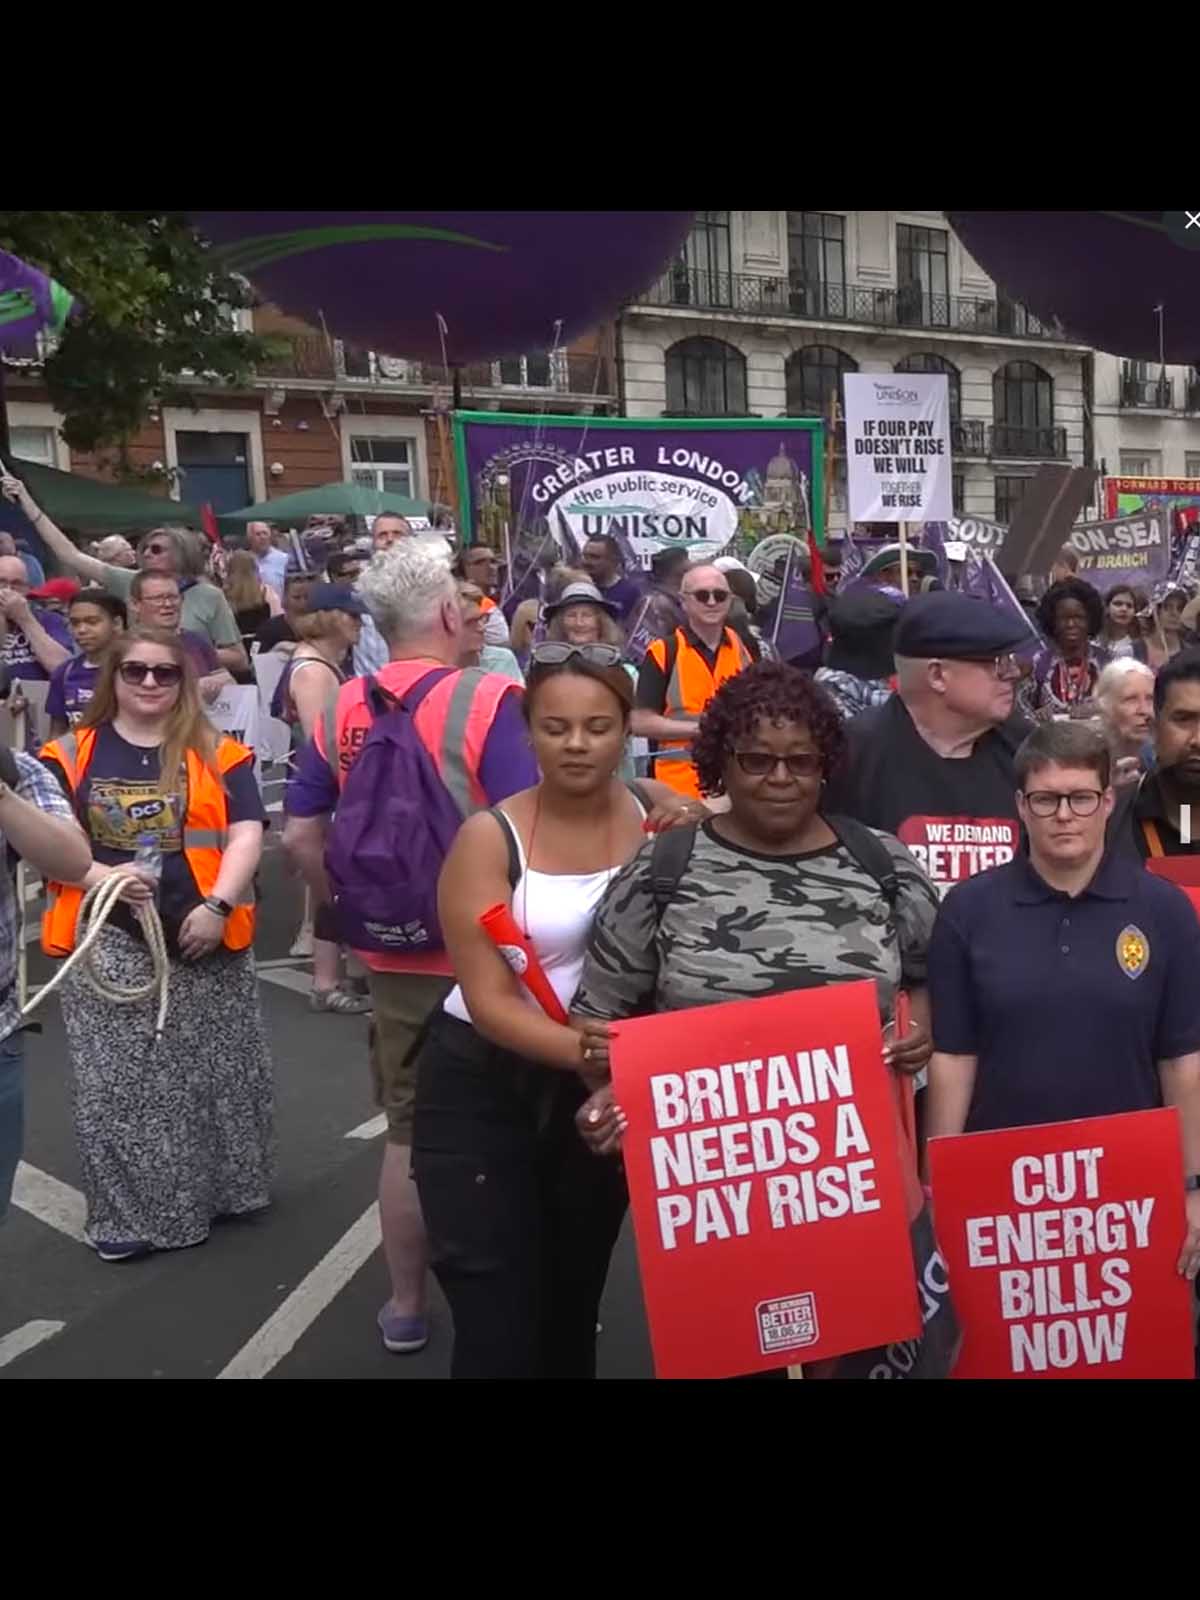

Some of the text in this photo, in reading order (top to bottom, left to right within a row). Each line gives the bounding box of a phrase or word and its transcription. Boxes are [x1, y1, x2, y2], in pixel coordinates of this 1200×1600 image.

[863, 420, 934, 436] IF OUR PAY
[854, 438, 945, 455] DOESN'T RISE
[532, 446, 754, 503] GREATER LONDON
[873, 458, 927, 474] WE WILL
[574, 475, 719, 508] the public service
[1116, 480, 1168, 490] FORWARD
[881, 494, 922, 507] WE RISE
[581, 514, 708, 540] UNISON
[1096, 552, 1148, 569] BRANCH
[131, 801, 162, 819] pcs
[926, 824, 1012, 843] WE DEMAND
[649, 1044, 854, 1129] BRITAIN
[650, 1103, 871, 1190] NEEDS A
[1011, 1147, 1104, 1206] CUT
[656, 1159, 880, 1250] PAY RISE
[965, 1198, 1155, 1267] ENERGY
[999, 1258, 1132, 1320] BILLS
[761, 1306, 811, 1328] BETTER
[1009, 1312, 1128, 1373] NOW
